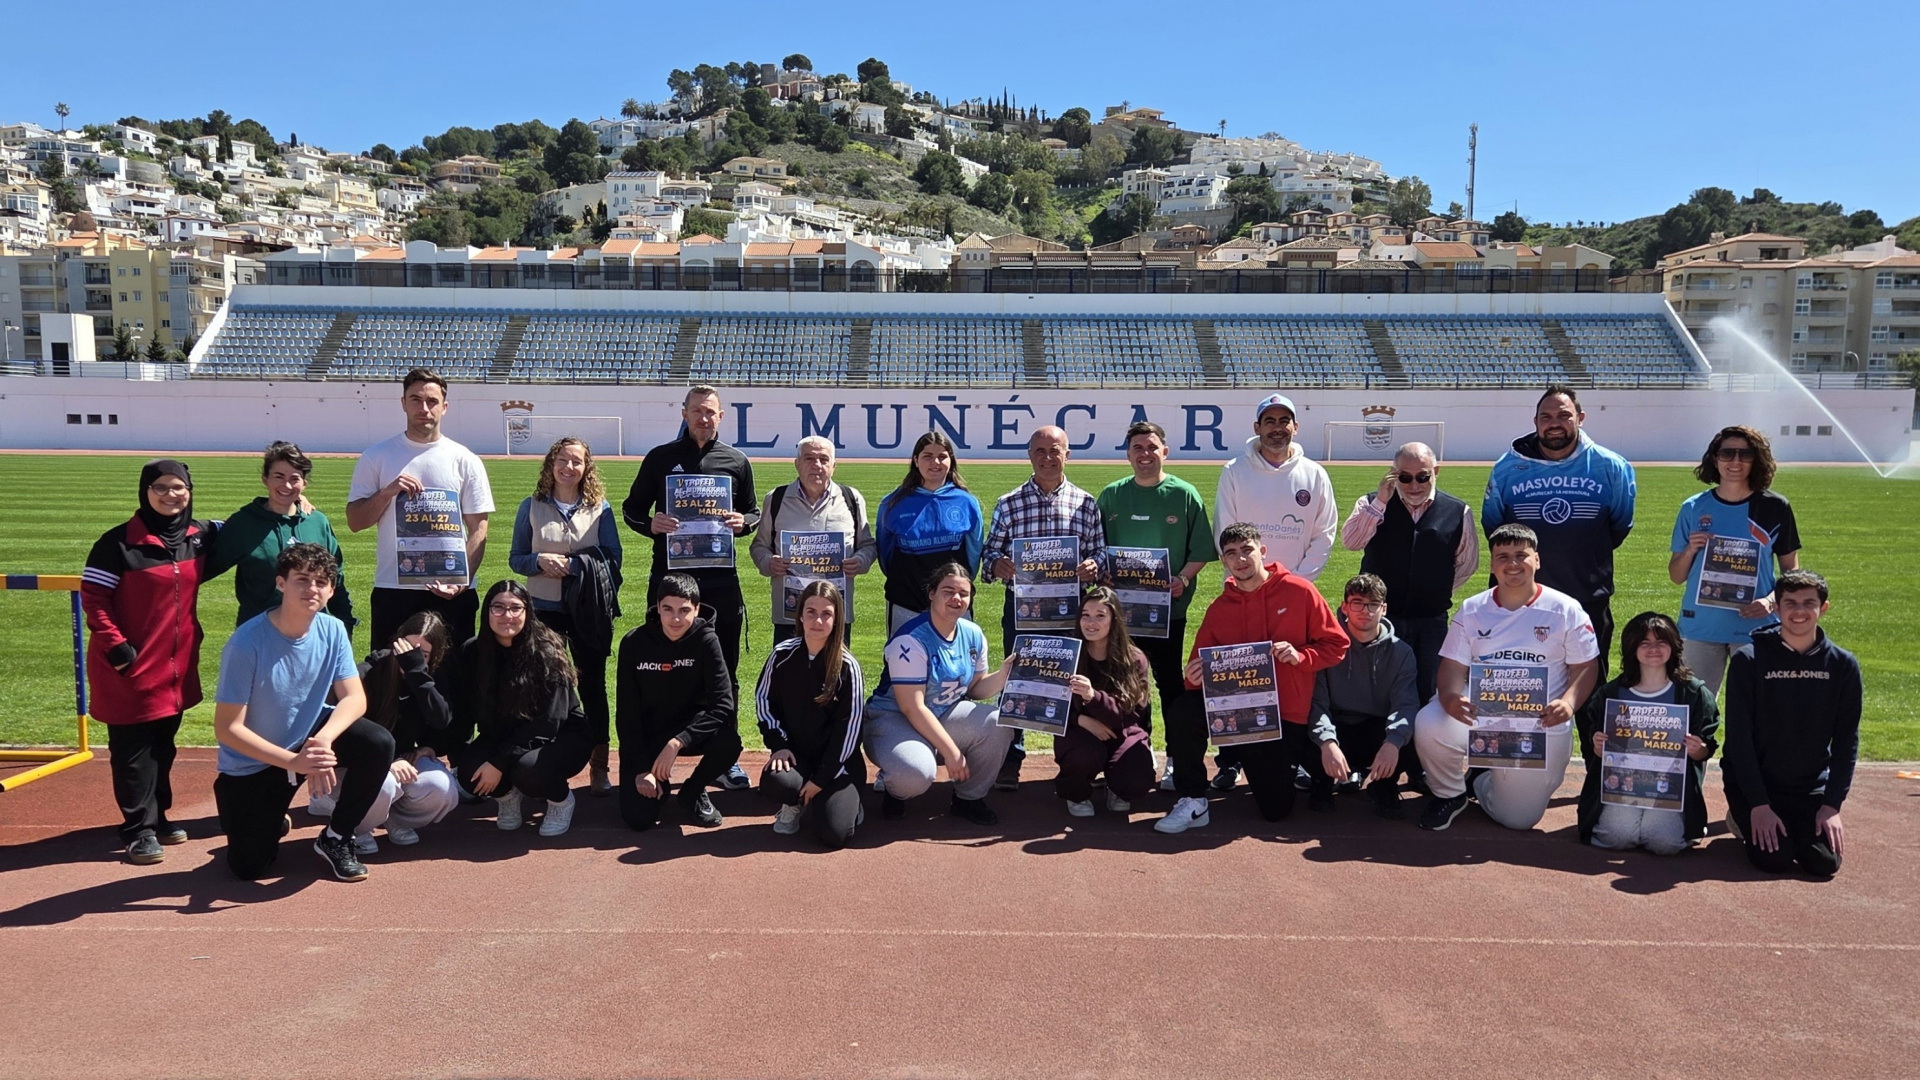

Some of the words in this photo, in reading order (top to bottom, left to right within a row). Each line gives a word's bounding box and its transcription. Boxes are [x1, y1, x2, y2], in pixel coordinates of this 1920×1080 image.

[677, 394, 1229, 451] LMUÑÉCAR
[677, 478, 684, 487] V
[1511, 476, 1603, 496] MASVOLEY21
[405, 514, 419, 522] 23
[421, 514, 435, 522] AL
[1248, 522, 1301, 534] entaDanés
[791, 536, 798, 544] V
[1025, 638, 1032, 647] V
[1212, 651, 1220, 660] V
[1494, 650, 1546, 663] DEGIRO
[637, 662, 661, 670] JACK
[673, 659, 693, 667] ONES
[1018, 659, 1030, 667] 23
[1032, 660, 1045, 668] AL
[1046, 661, 1060, 669] 27
[1039, 669, 1070, 680] MARZO
[1212, 673, 1226, 682] 23
[1229, 671, 1242, 680] AL
[1244, 670, 1257, 679] 27
[1483, 669, 1492, 678] V
[1765, 670, 1830, 679] JACK&JONES
[1238, 678, 1271, 687] MARZO
[1480, 692, 1495, 701] 23
[1498, 693, 1513, 702] AL
[1515, 694, 1530, 702] 27
[1508, 703, 1543, 711] MARZO
[1619, 705, 1628, 714] V
[1616, 728, 1631, 737] 23
[1634, 730, 1650, 739] AL
[1652, 731, 1668, 740] 27
[1644, 740, 1681, 750] MARZO
